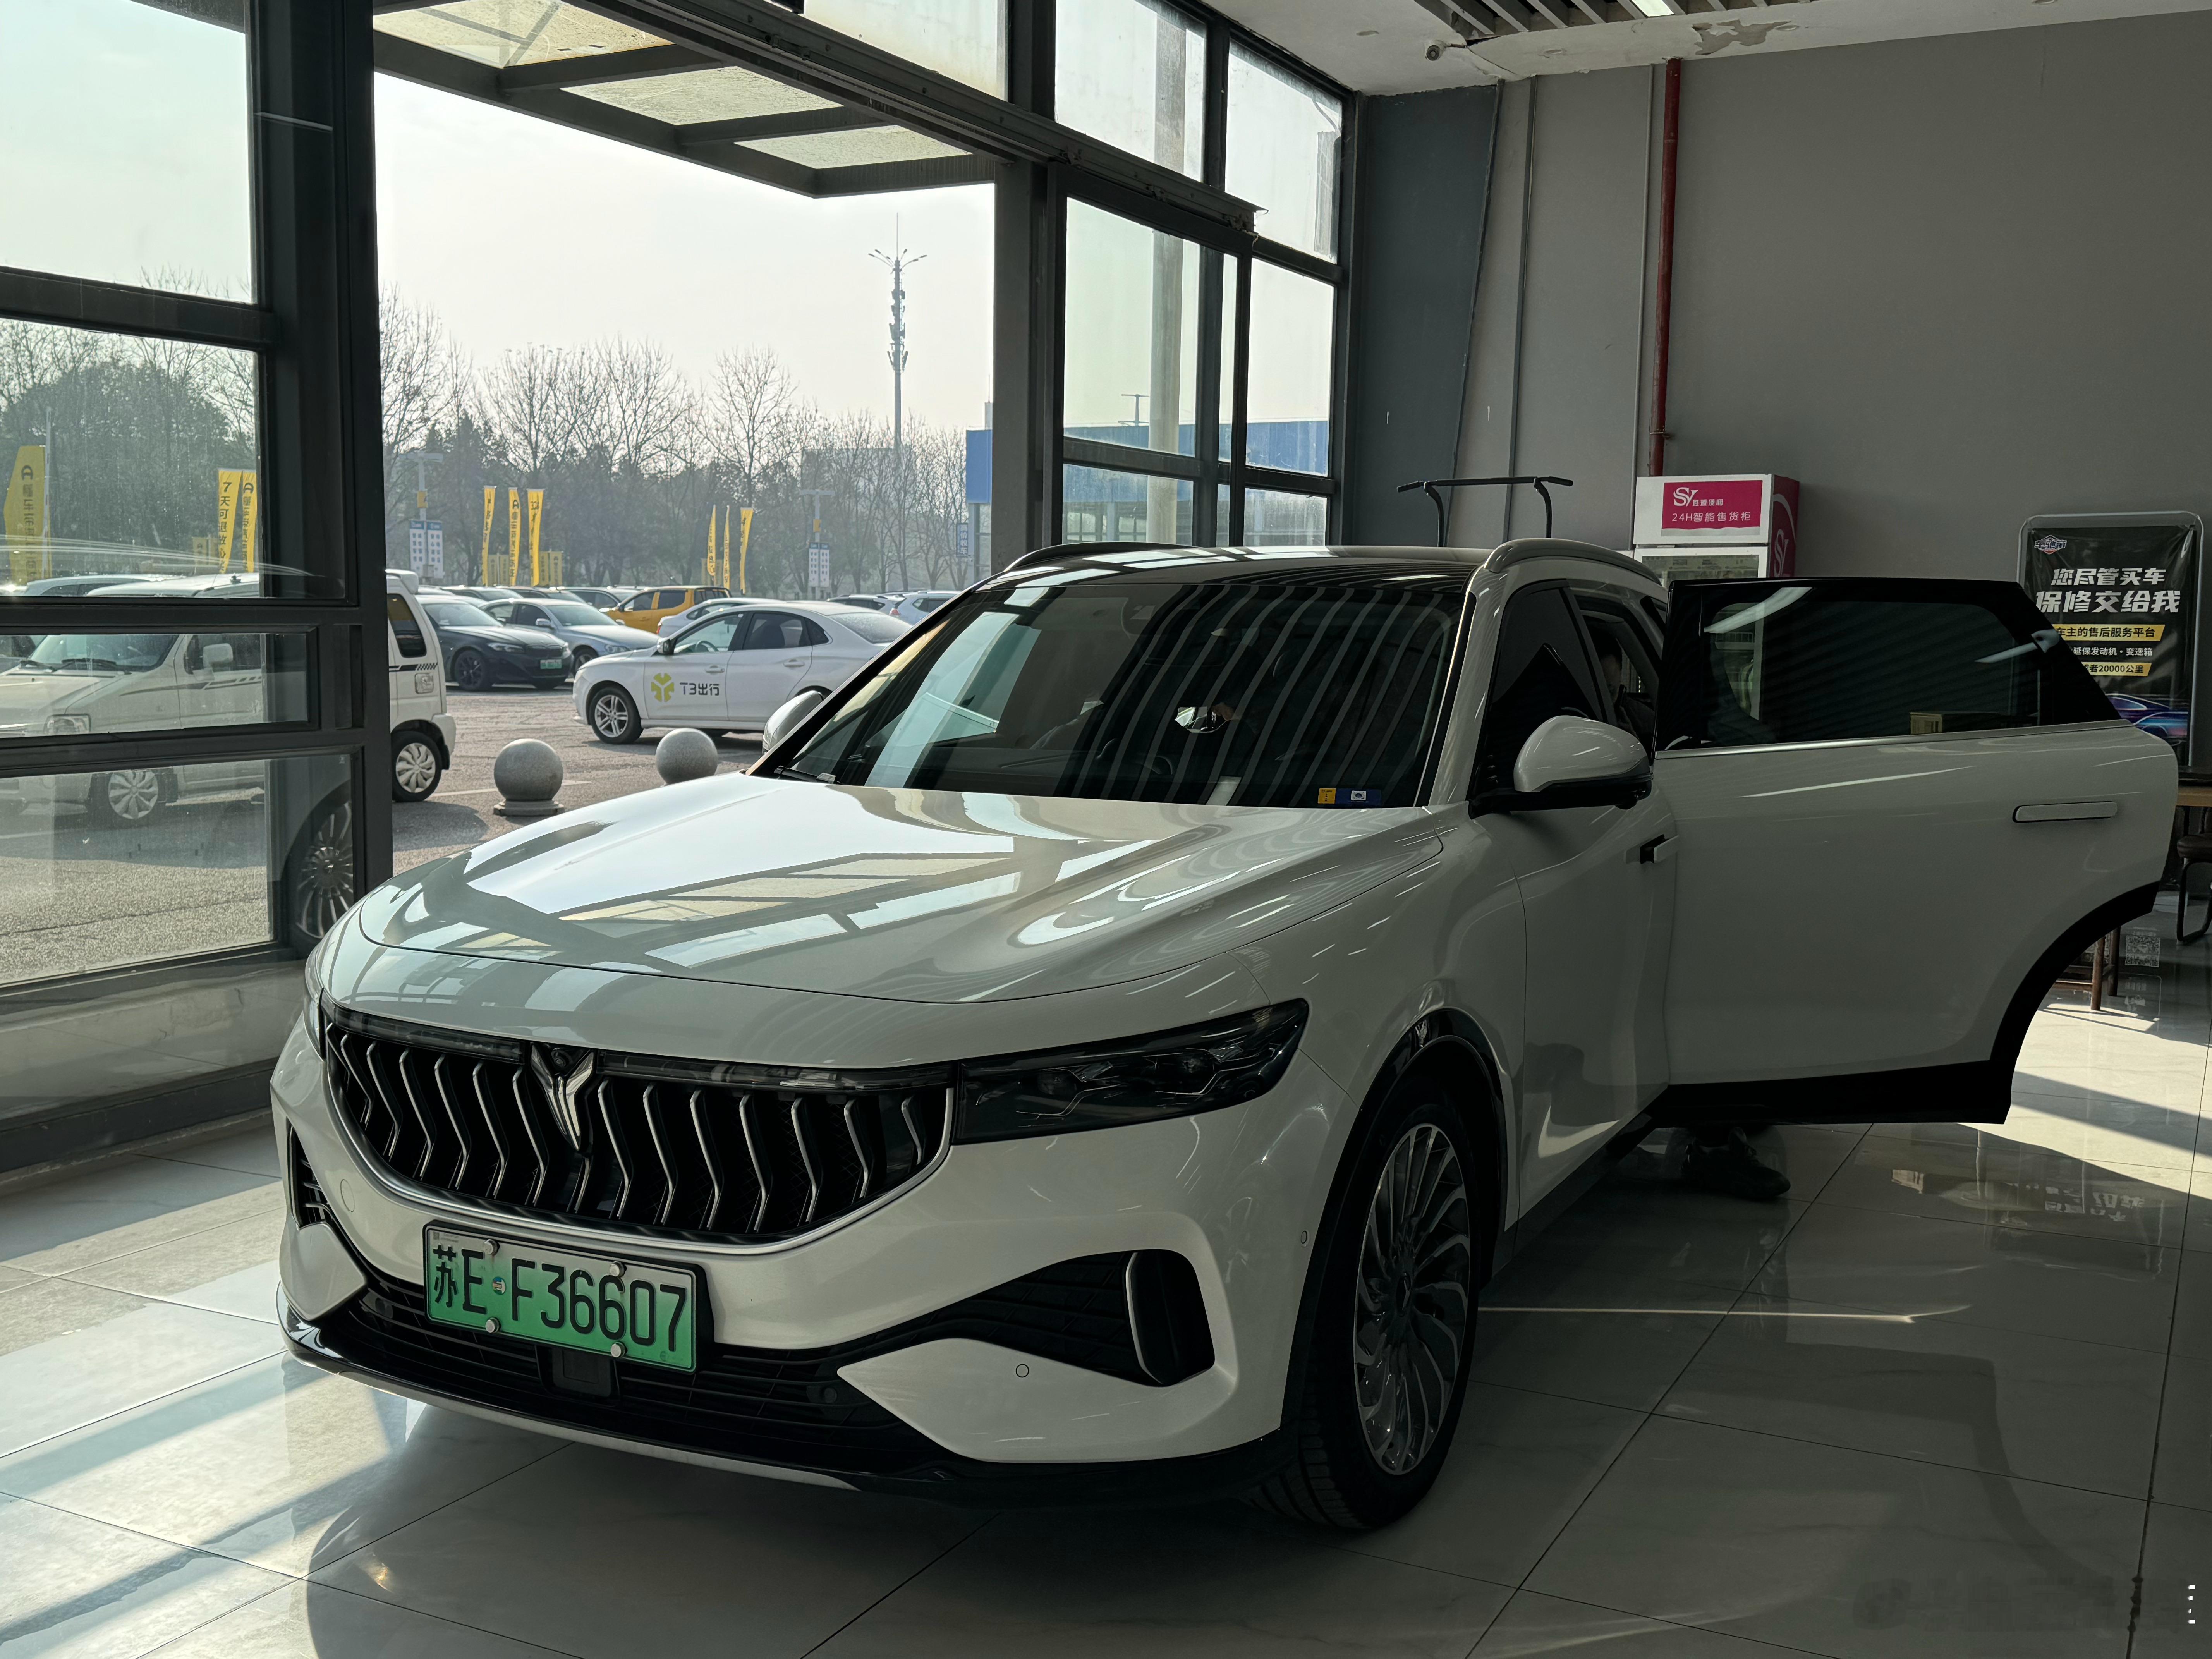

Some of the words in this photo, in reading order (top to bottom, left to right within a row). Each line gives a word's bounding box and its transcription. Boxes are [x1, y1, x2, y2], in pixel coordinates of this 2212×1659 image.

[1672, 511, 1751, 522] 24H智能售货柜
[2051, 568, 2166, 586] 您尽管买车
[2036, 590, 2181, 613] 保修交给我
[2071, 647, 2153, 656] 延保发动机·变速箱
[680, 682, 719, 696] T3出行
